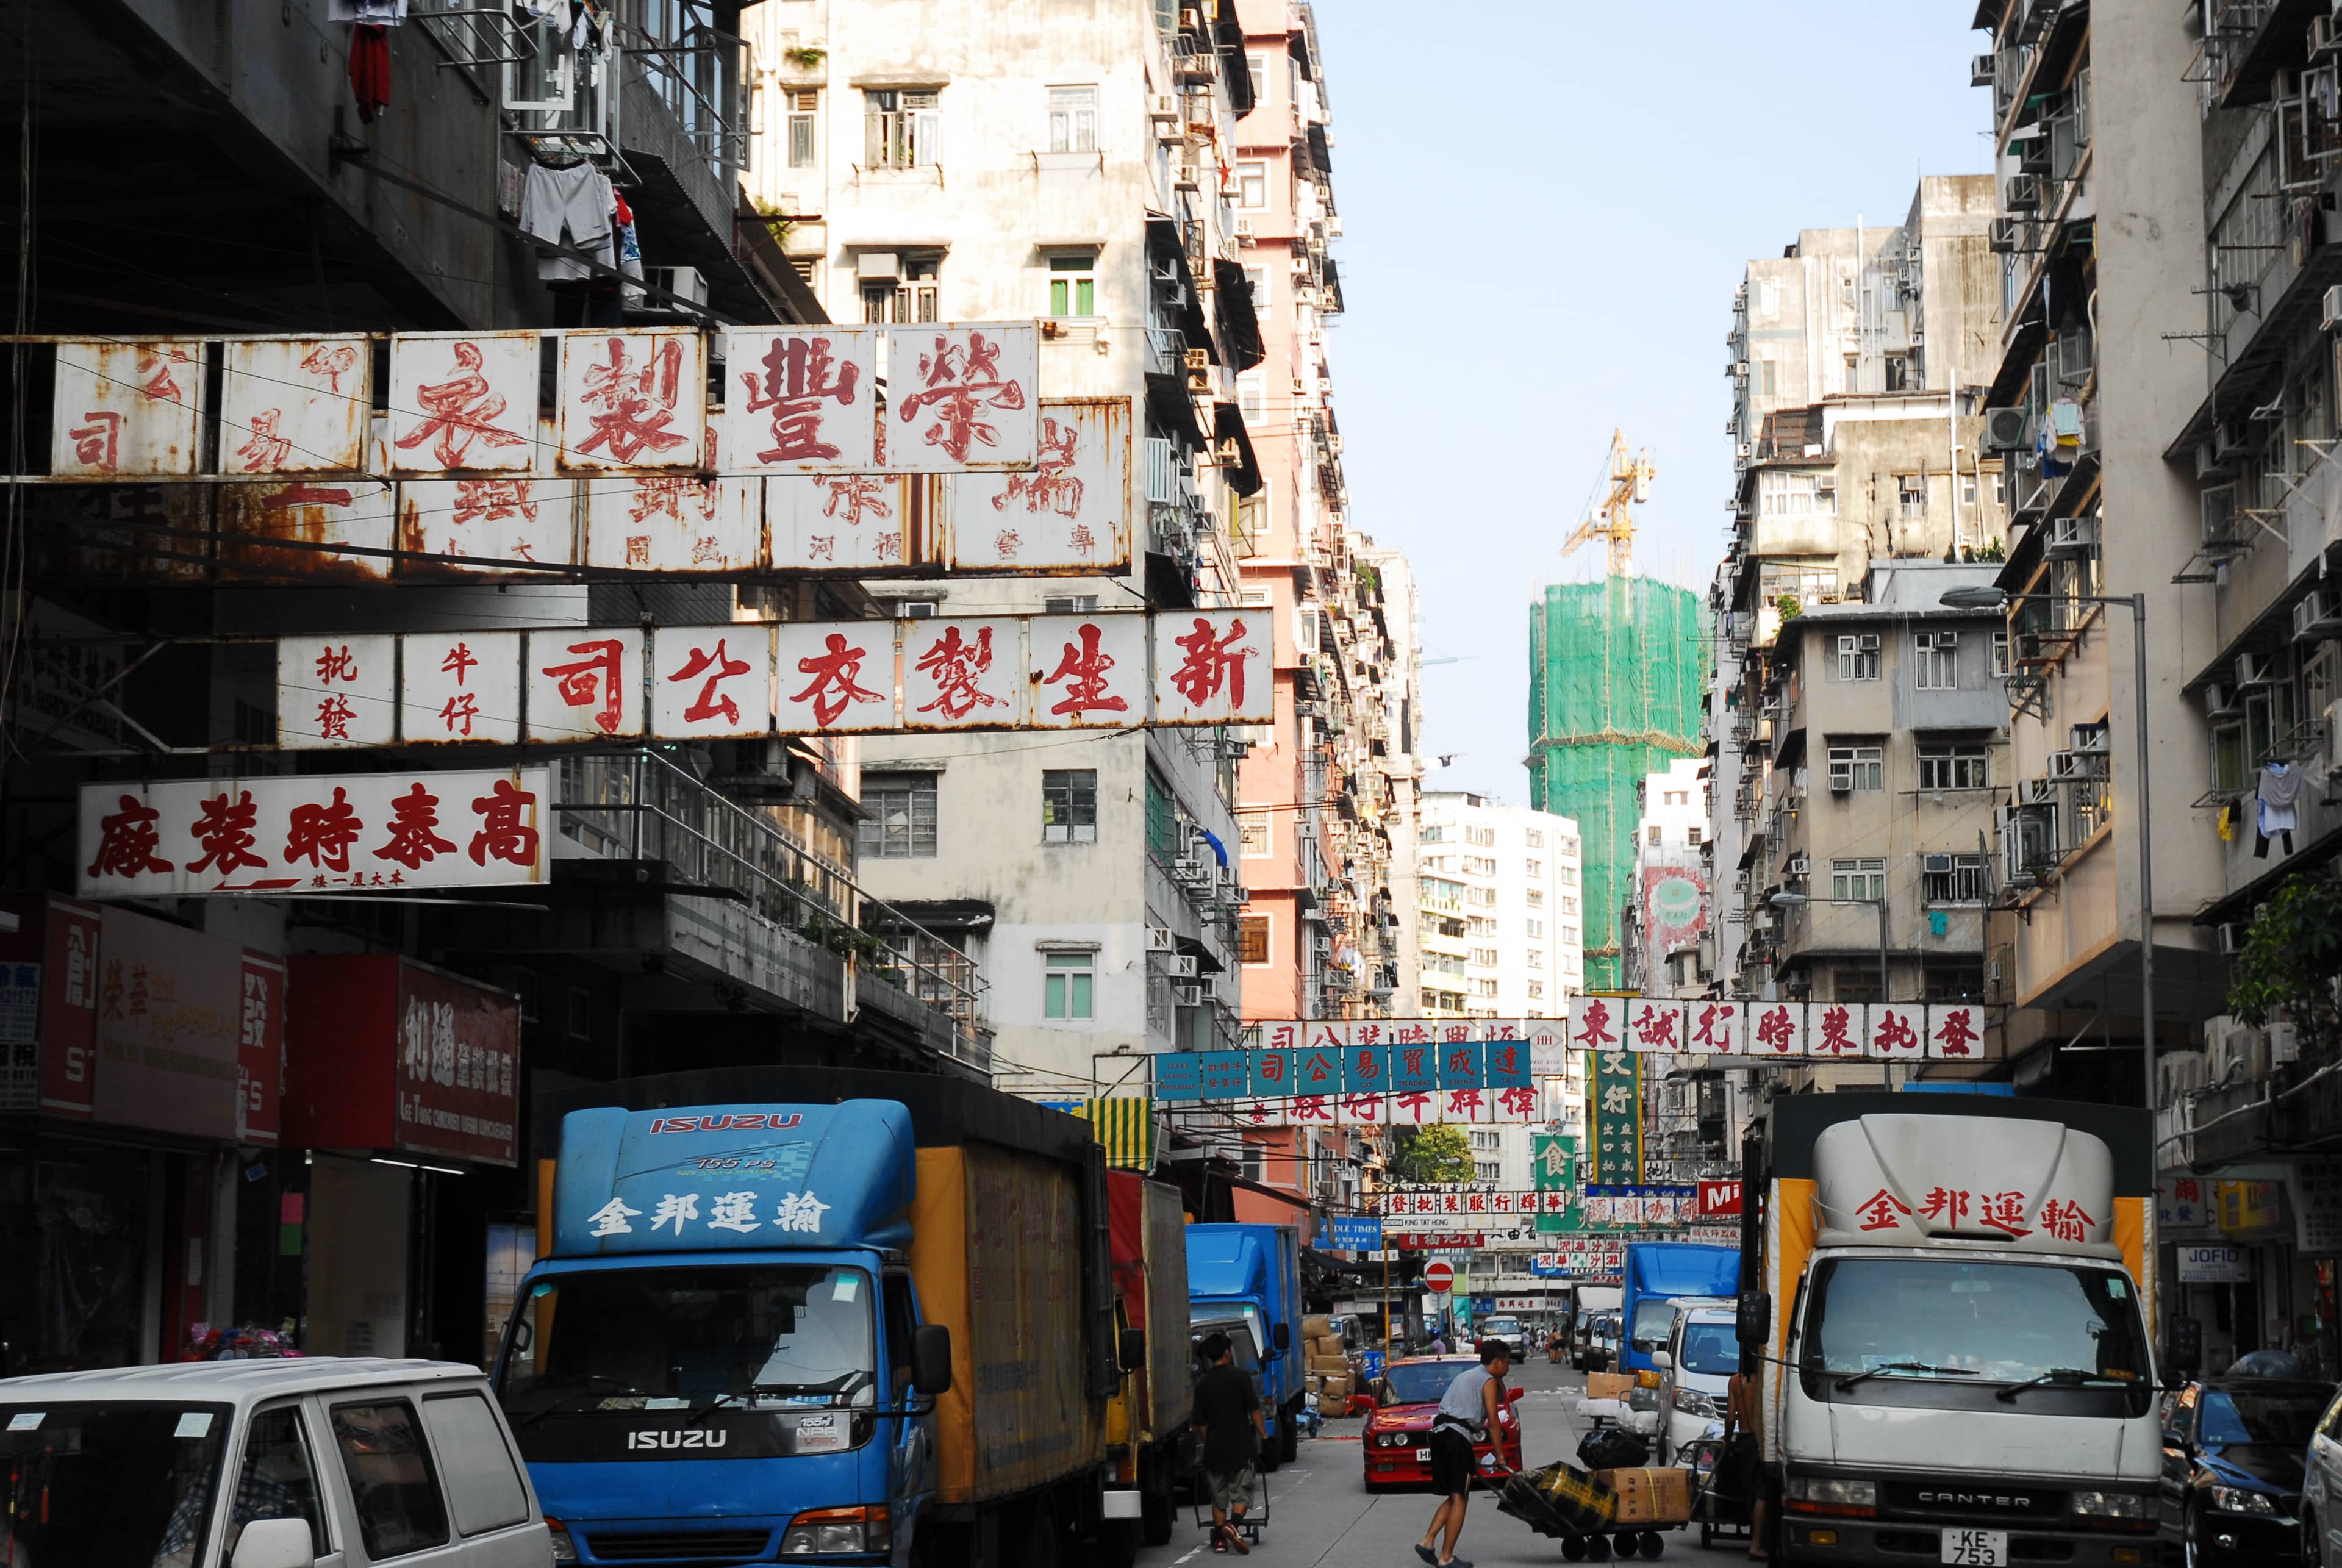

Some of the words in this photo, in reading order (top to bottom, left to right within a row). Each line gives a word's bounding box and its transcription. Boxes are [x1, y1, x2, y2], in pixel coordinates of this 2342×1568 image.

[542, 618, 1259, 733] 新生製衣公司
[314, 645, 358, 739] 批發
[439, 642, 479, 736] 牛仔
[87, 779, 539, 878] 高泰時裝廠
[1574, 998, 1980, 1056] 東誠行時裝批發
[1260, 1045, 1522, 1083] 達成貿易公司
[650, 1114, 803, 1134] ISUZU
[696, 1158, 742, 1169] 155
[745, 1159, 777, 1169] PS
[1391, 1193, 1563, 1213] 華輝行服裝批發
[587, 1190, 831, 1237] 金邦運輸
[1855, 1186, 2096, 1242] 金邦運輸
[2190, 1248, 2239, 1262] JOFID
[628, 1430, 726, 1450] ISUZU
[797, 1436, 839, 1445] TURBO
[1919, 1490, 2032, 1508] CANTER
[1960, 1530, 1988, 1548] KE
[1953, 1548, 1997, 1566] 753
